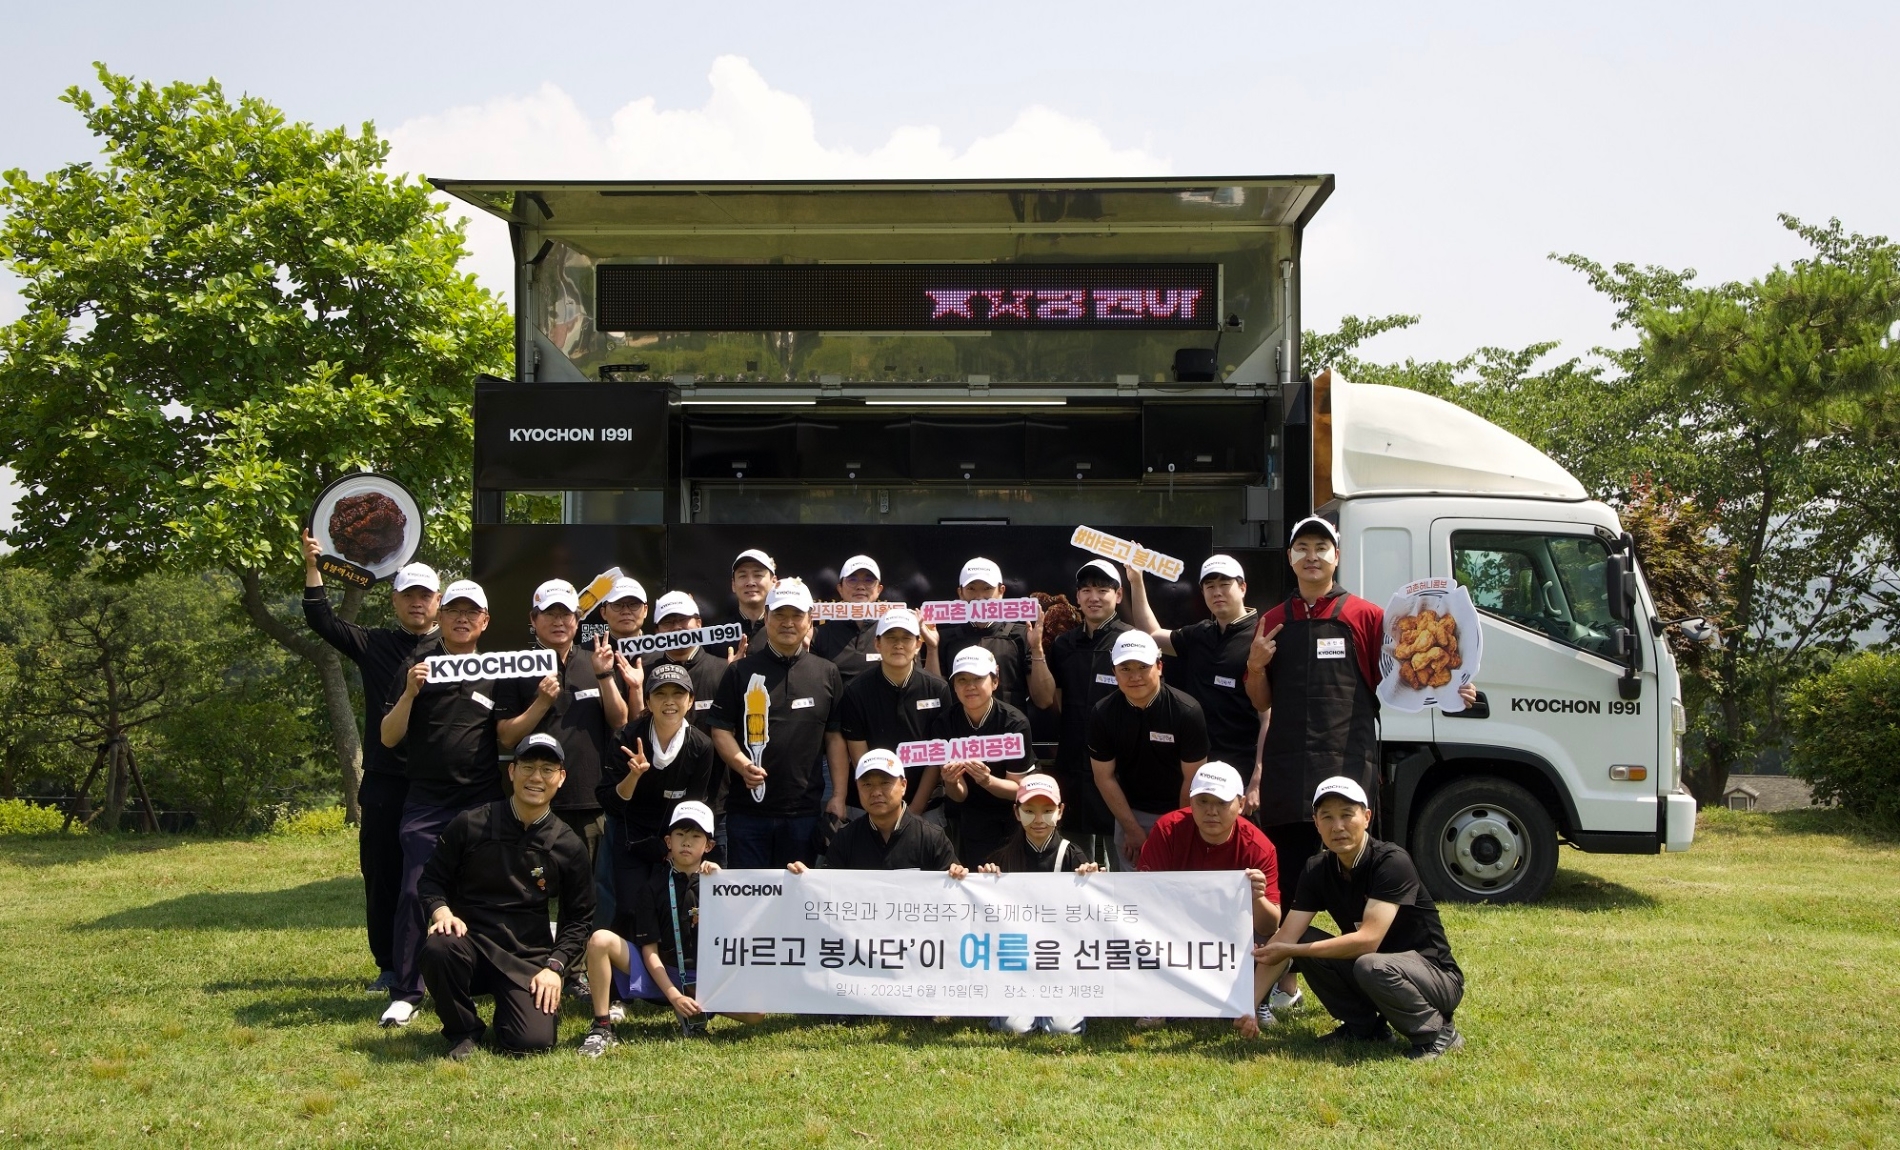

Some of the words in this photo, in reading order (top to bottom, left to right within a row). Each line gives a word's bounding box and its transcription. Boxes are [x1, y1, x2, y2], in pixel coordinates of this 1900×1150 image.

[509, 427, 595, 442] KYOCHON
[601, 427, 633, 442] 1991
[1073, 528, 1132, 561] #바르고
[1131, 548, 1181, 579] 봉사단
[1405, 579, 1448, 594] 교촌허니콤보
[810, 604, 848, 619] 임직원
[923, 602, 967, 622] #교촌
[970, 600, 1037, 620] 사회공헌
[620, 630, 704, 654] KYOCHON
[709, 625, 740, 641] 1991
[430, 654, 553, 678] KYOCHON
[1511, 698, 1601, 714] KYOCHON
[1608, 701, 1641, 715] 1991
[899, 742, 946, 764] #교촌
[950, 736, 1022, 760] 사회공헌
[712, 884, 783, 897] KYOCHON
[804, 900, 878, 921] 임직원과
[885, 901, 978, 922] 가맹점주가
[984, 902, 1057, 923] 함께하는
[1065, 903, 1139, 924] 봉사활동
[959, 932, 1062, 972] 여름을
[1073, 938, 1236, 972] 선물합니다!
[835, 982, 859, 997] 일시
[871, 984, 913, 998] 2023년
[916, 984, 937, 998] 6월
[941, 984, 989, 999] 15일(목)
[1003, 984, 1027, 998] 장소
[1039, 984, 1063, 998] 인천
[1068, 984, 1105, 998] 계명원
